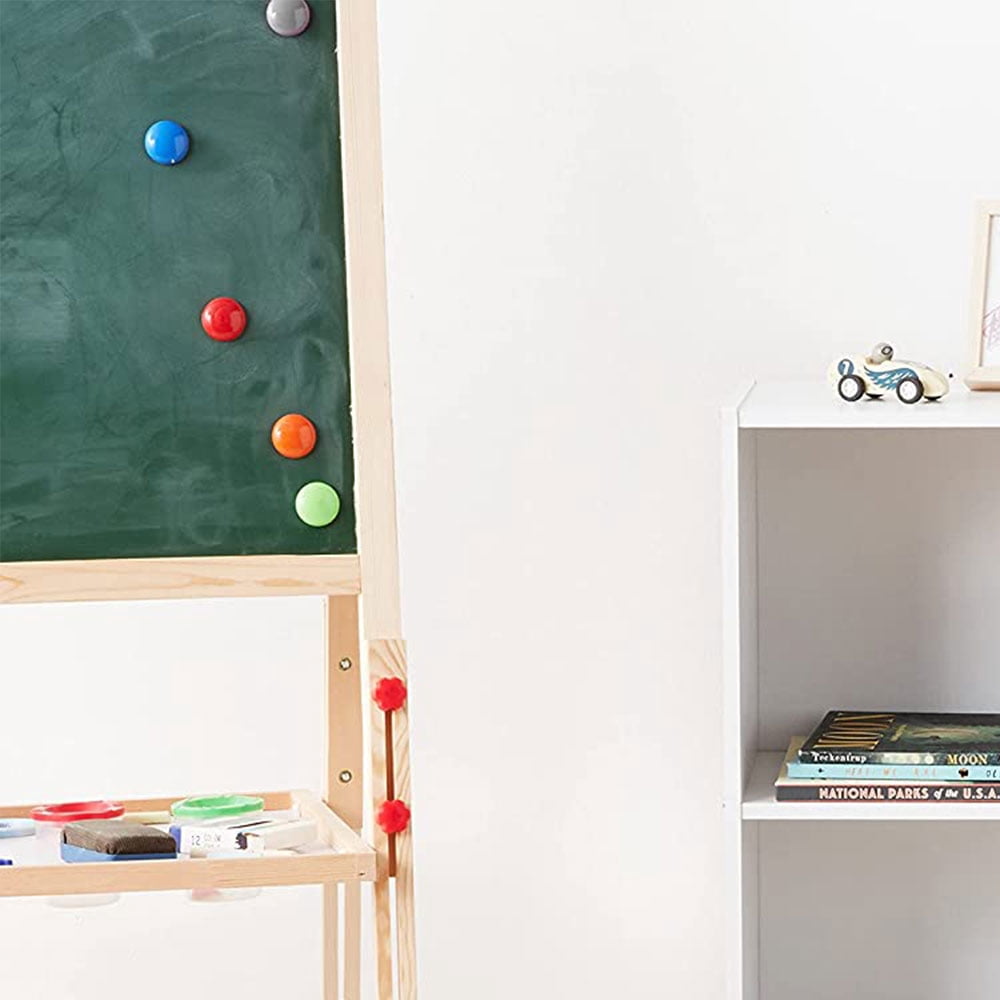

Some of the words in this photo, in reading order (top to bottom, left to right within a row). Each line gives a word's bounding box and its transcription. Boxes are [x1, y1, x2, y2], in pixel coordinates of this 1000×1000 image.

[947, 753, 988, 765] MOON
[819, 787, 884, 799] NATIONAL
[888, 787, 929, 799] PARKS
[933, 788, 944, 800] of
[945, 788, 959, 798] the
[963, 787, 1000, 799] U.S.A.
